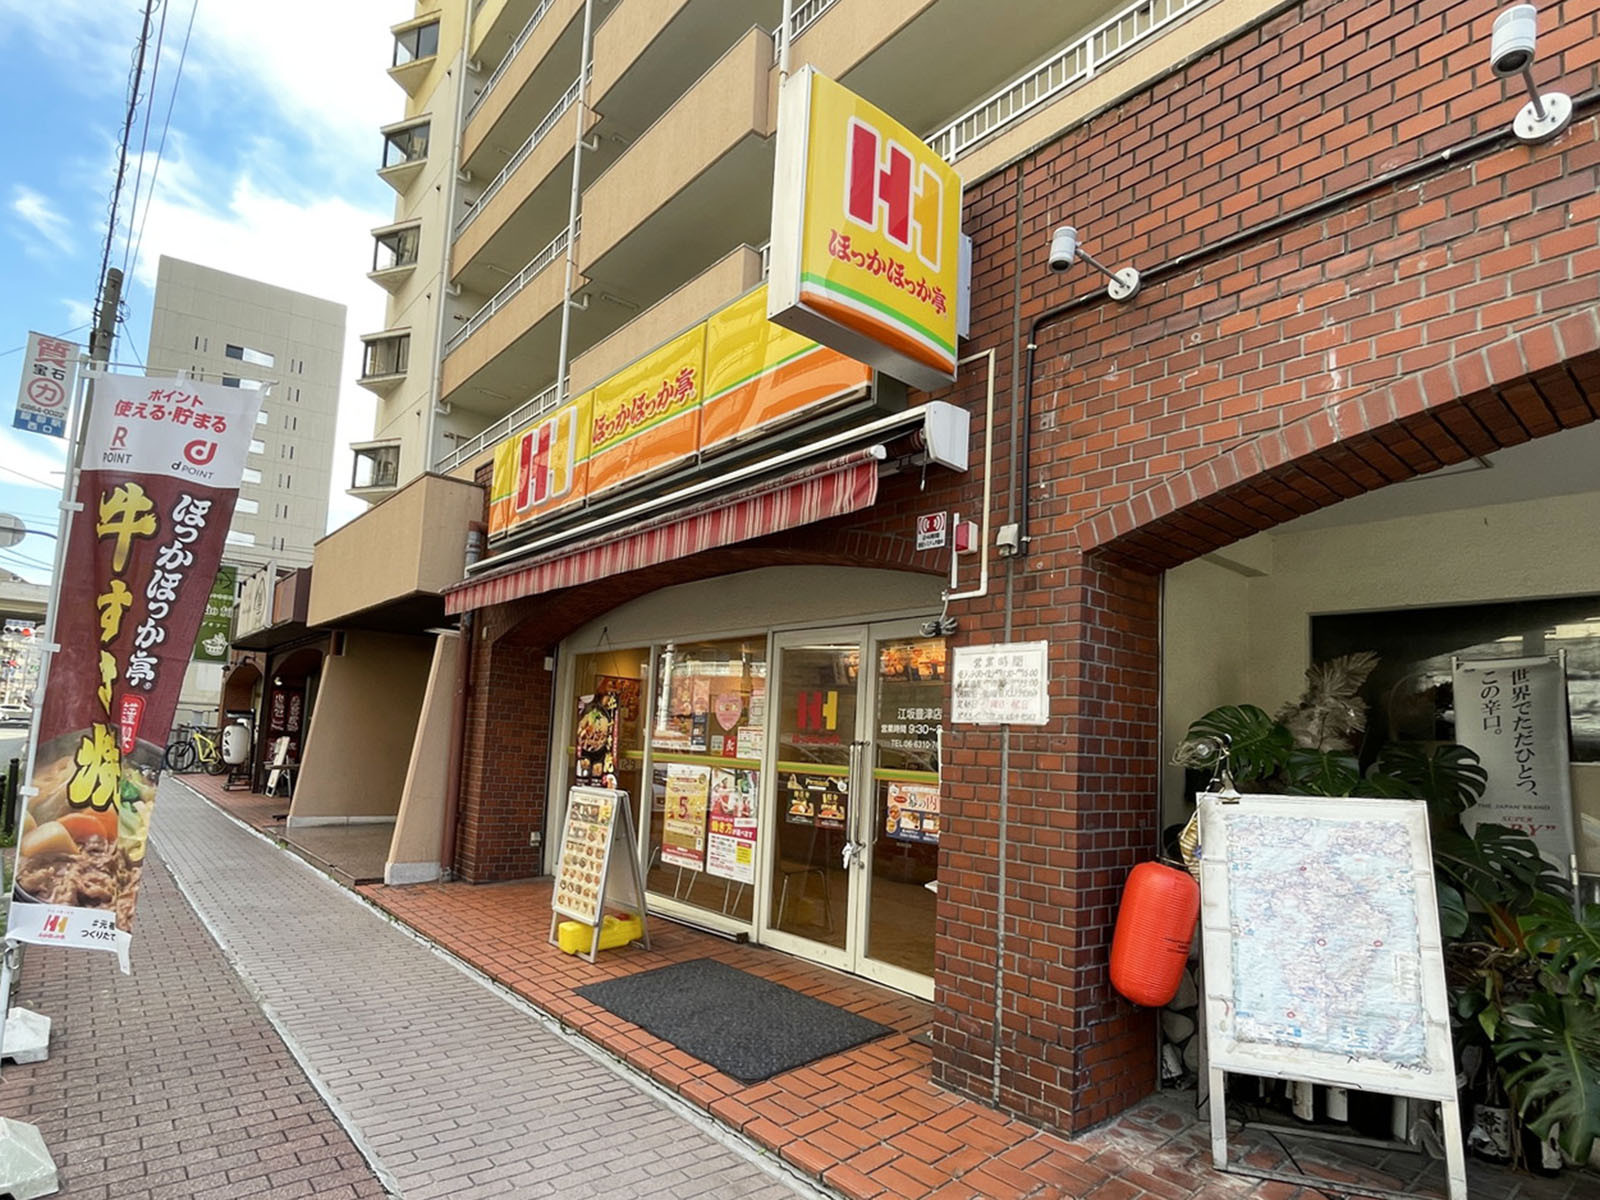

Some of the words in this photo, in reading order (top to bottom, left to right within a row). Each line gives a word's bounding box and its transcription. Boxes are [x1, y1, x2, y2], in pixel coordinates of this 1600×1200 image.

[828, 228, 947, 315] ほっかほっか亭
[35, 337, 71, 369] 質
[148, 389, 204, 408] ポイント
[592, 367, 695, 444] ほっかほっか亭
[114, 399, 227, 434] 使える・貯まる
[110, 426, 128, 448] R
[103, 452, 133, 465] POINT
[171, 461, 181, 471] d
[181, 464, 215, 480] POINT
[126, 494, 213, 687] ほっかほっか亭
[1480, 670, 1503, 735] この辛口。
[1511, 668, 1538, 797] 世界でただひとつ、
[81, 929, 116, 941] つくりたて
